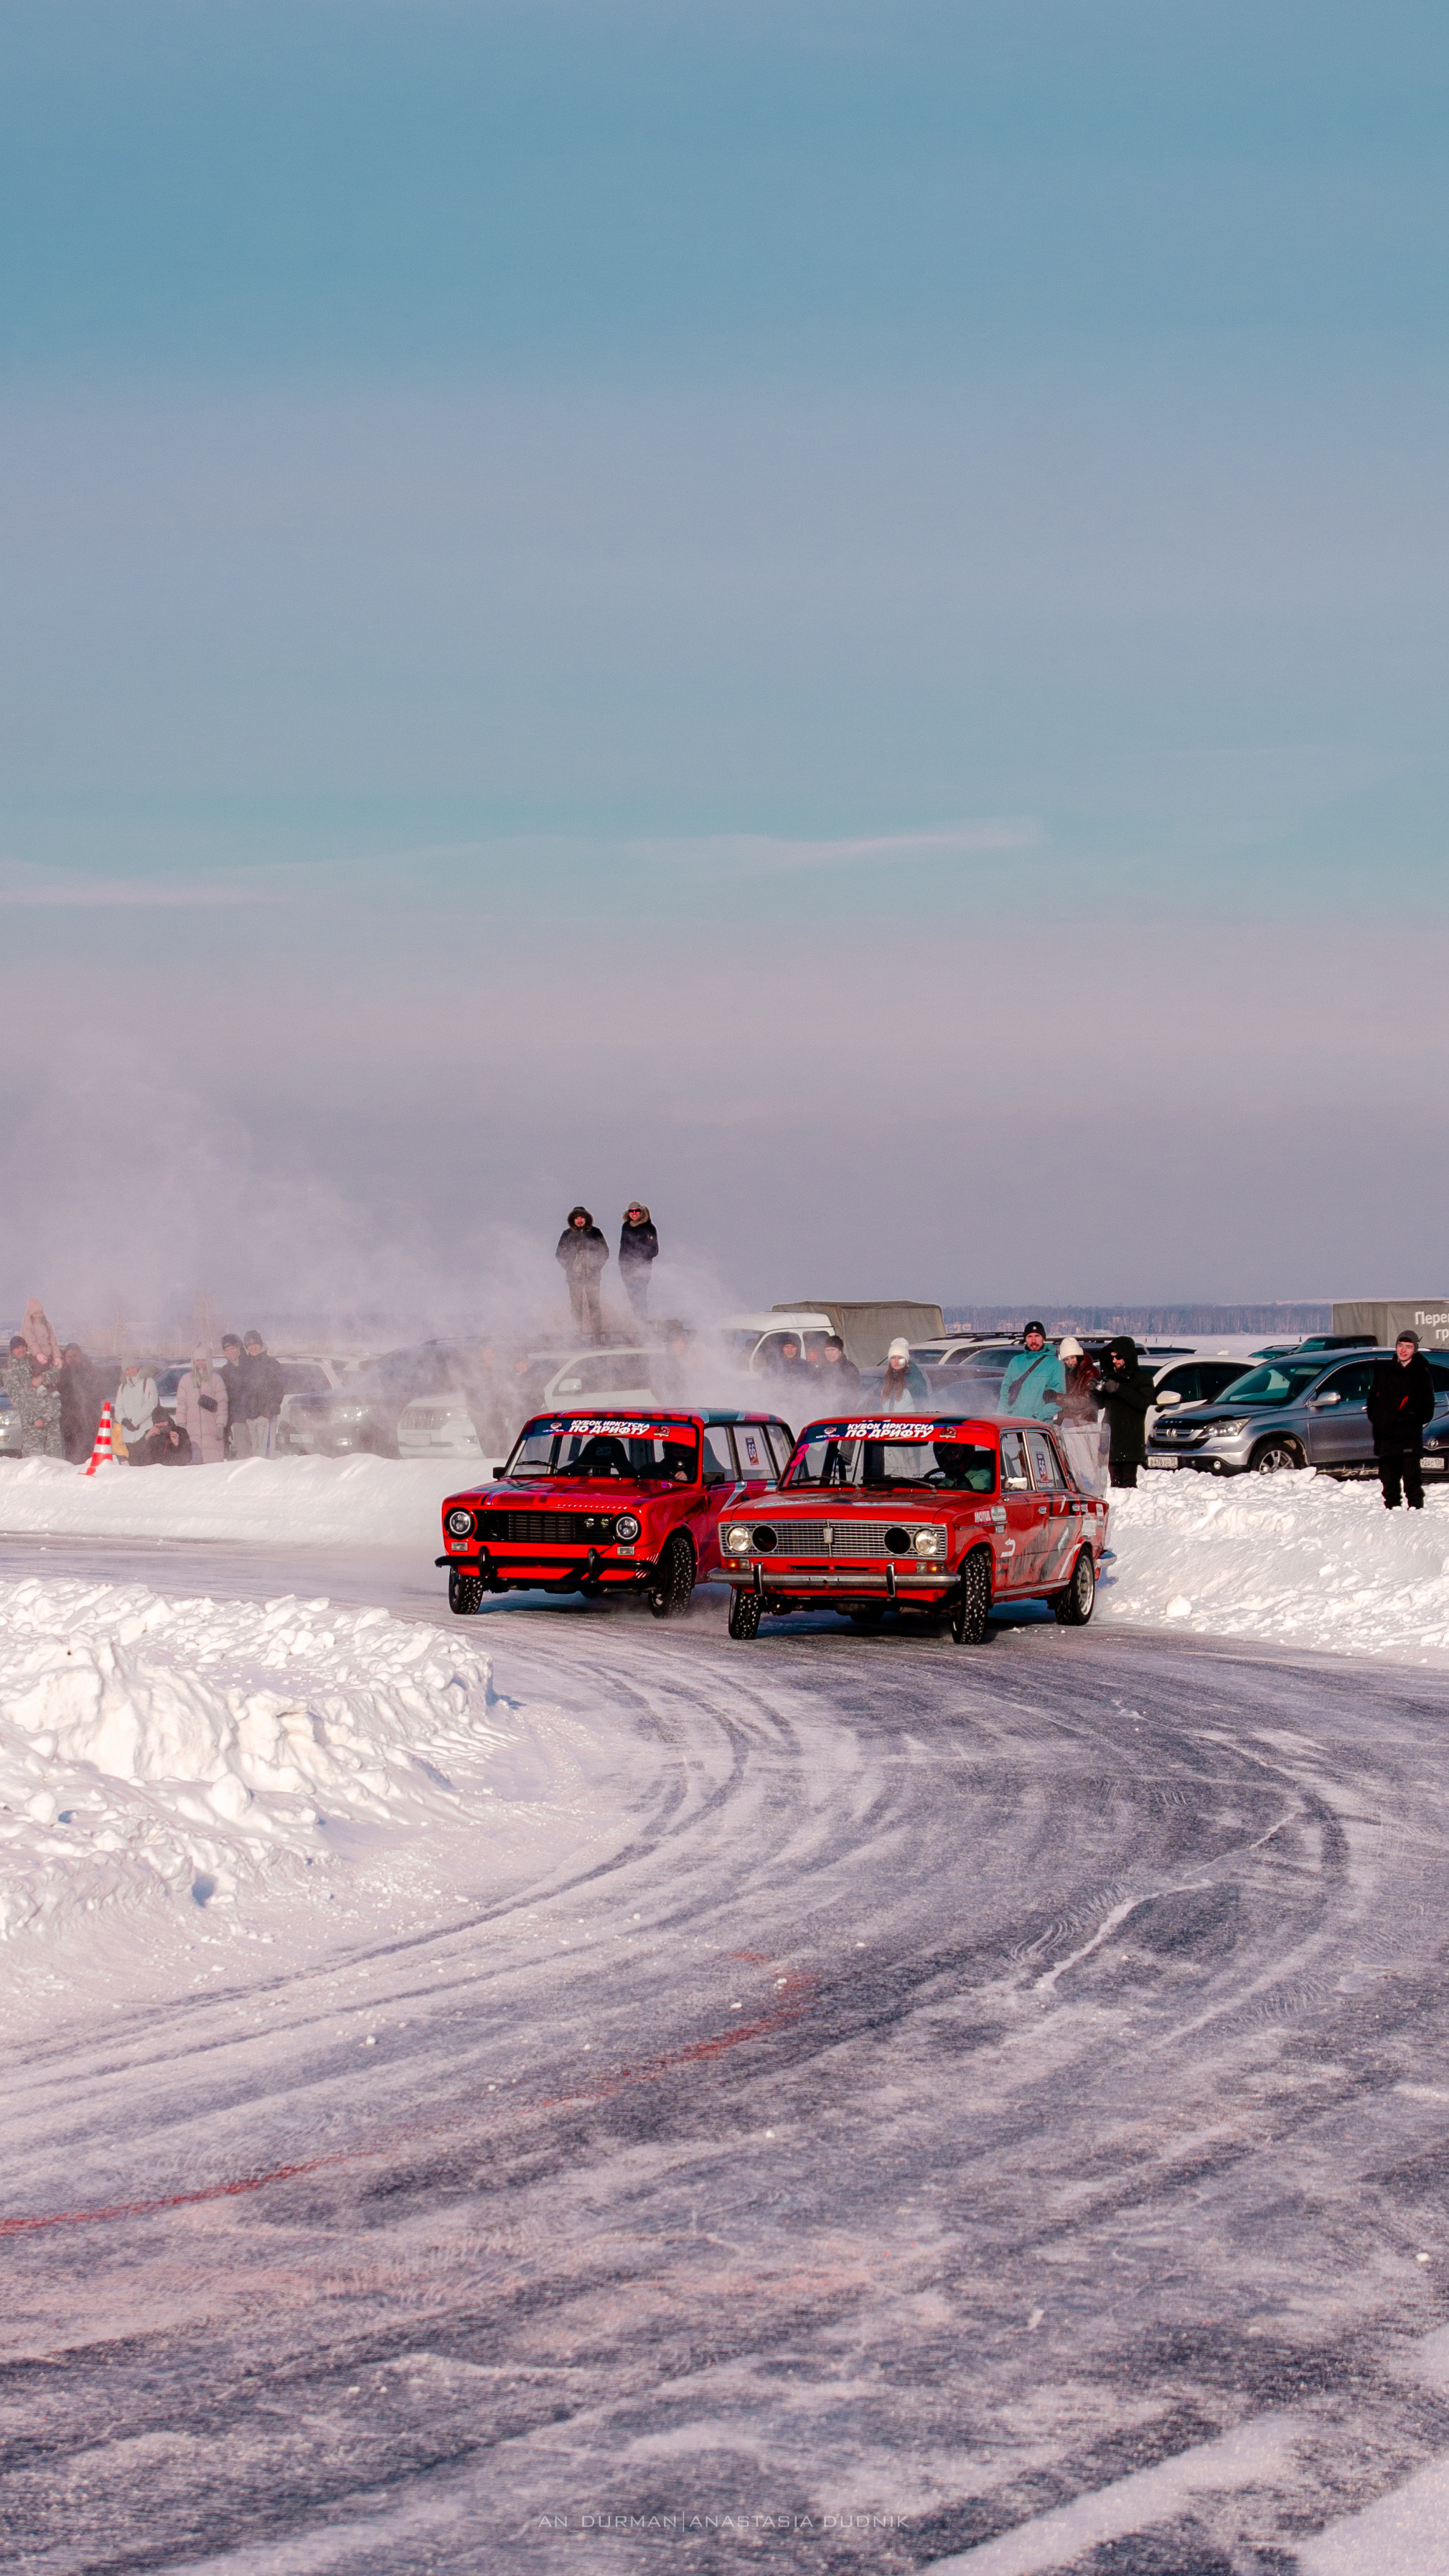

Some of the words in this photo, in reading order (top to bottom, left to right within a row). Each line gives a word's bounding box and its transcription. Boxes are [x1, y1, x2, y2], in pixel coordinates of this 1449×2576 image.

[1415, 1311, 1449, 1326] Пере
[604, 1420, 650, 1429] ИРКУТСКА
[589, 1425, 648, 1435] ДРИФТУ
[845, 1429, 868, 1438] ПО
[868, 1429, 933, 1438] ДРИФТУ
[748, 1443, 756, 1458] 66
